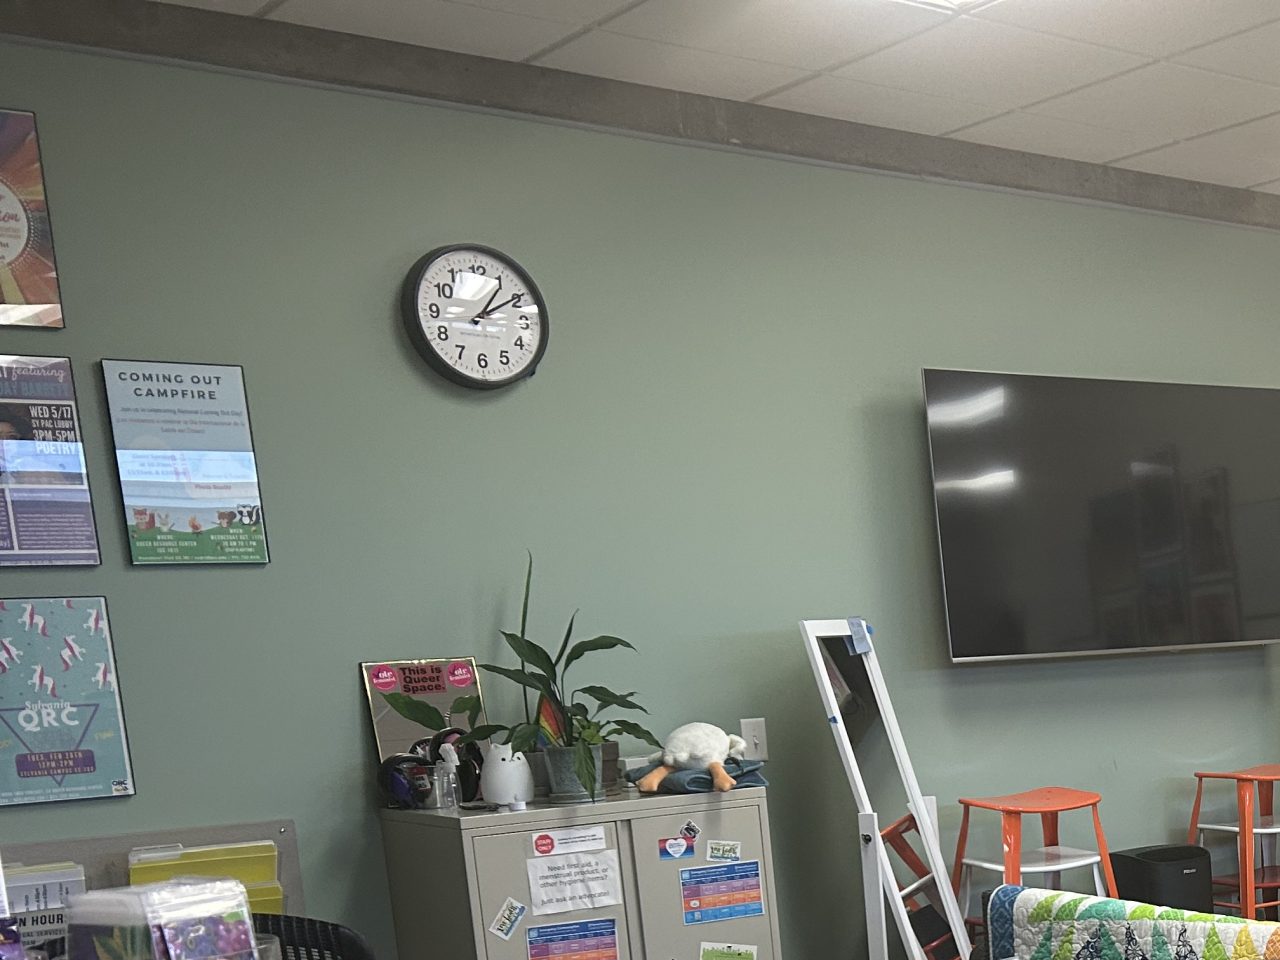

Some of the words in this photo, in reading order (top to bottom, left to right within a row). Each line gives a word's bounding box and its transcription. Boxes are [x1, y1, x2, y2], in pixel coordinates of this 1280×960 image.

[468, 264, 486, 276] 12
[434, 283, 453, 299] 10
[511, 293, 522, 308] 2
[428, 303, 440, 319] 9
[519, 315, 530, 330] 3
[437, 326, 448, 341] 8
[514, 336, 525, 350] 4
[455, 345, 465, 360] 7
[499, 350, 510, 365] 5
[477, 353, 488, 368] 6
[12, 365, 65, 382] featuring
[118, 371, 184, 384] COMING
[190, 375, 222, 386] OUT
[133, 387, 217, 400] CAMPFIRE
[29, 405, 49, 418] WED
[51, 406, 71, 419] 5/17
[33, 430, 76, 442] 3PM-5PM
[37, 442, 76, 454] POETRY
[400, 667, 427, 676] This
[431, 665, 442, 674] is
[403, 675, 441, 684] Queer
[403, 683, 446, 694] Space.
[18, 706, 79, 732] QRC
